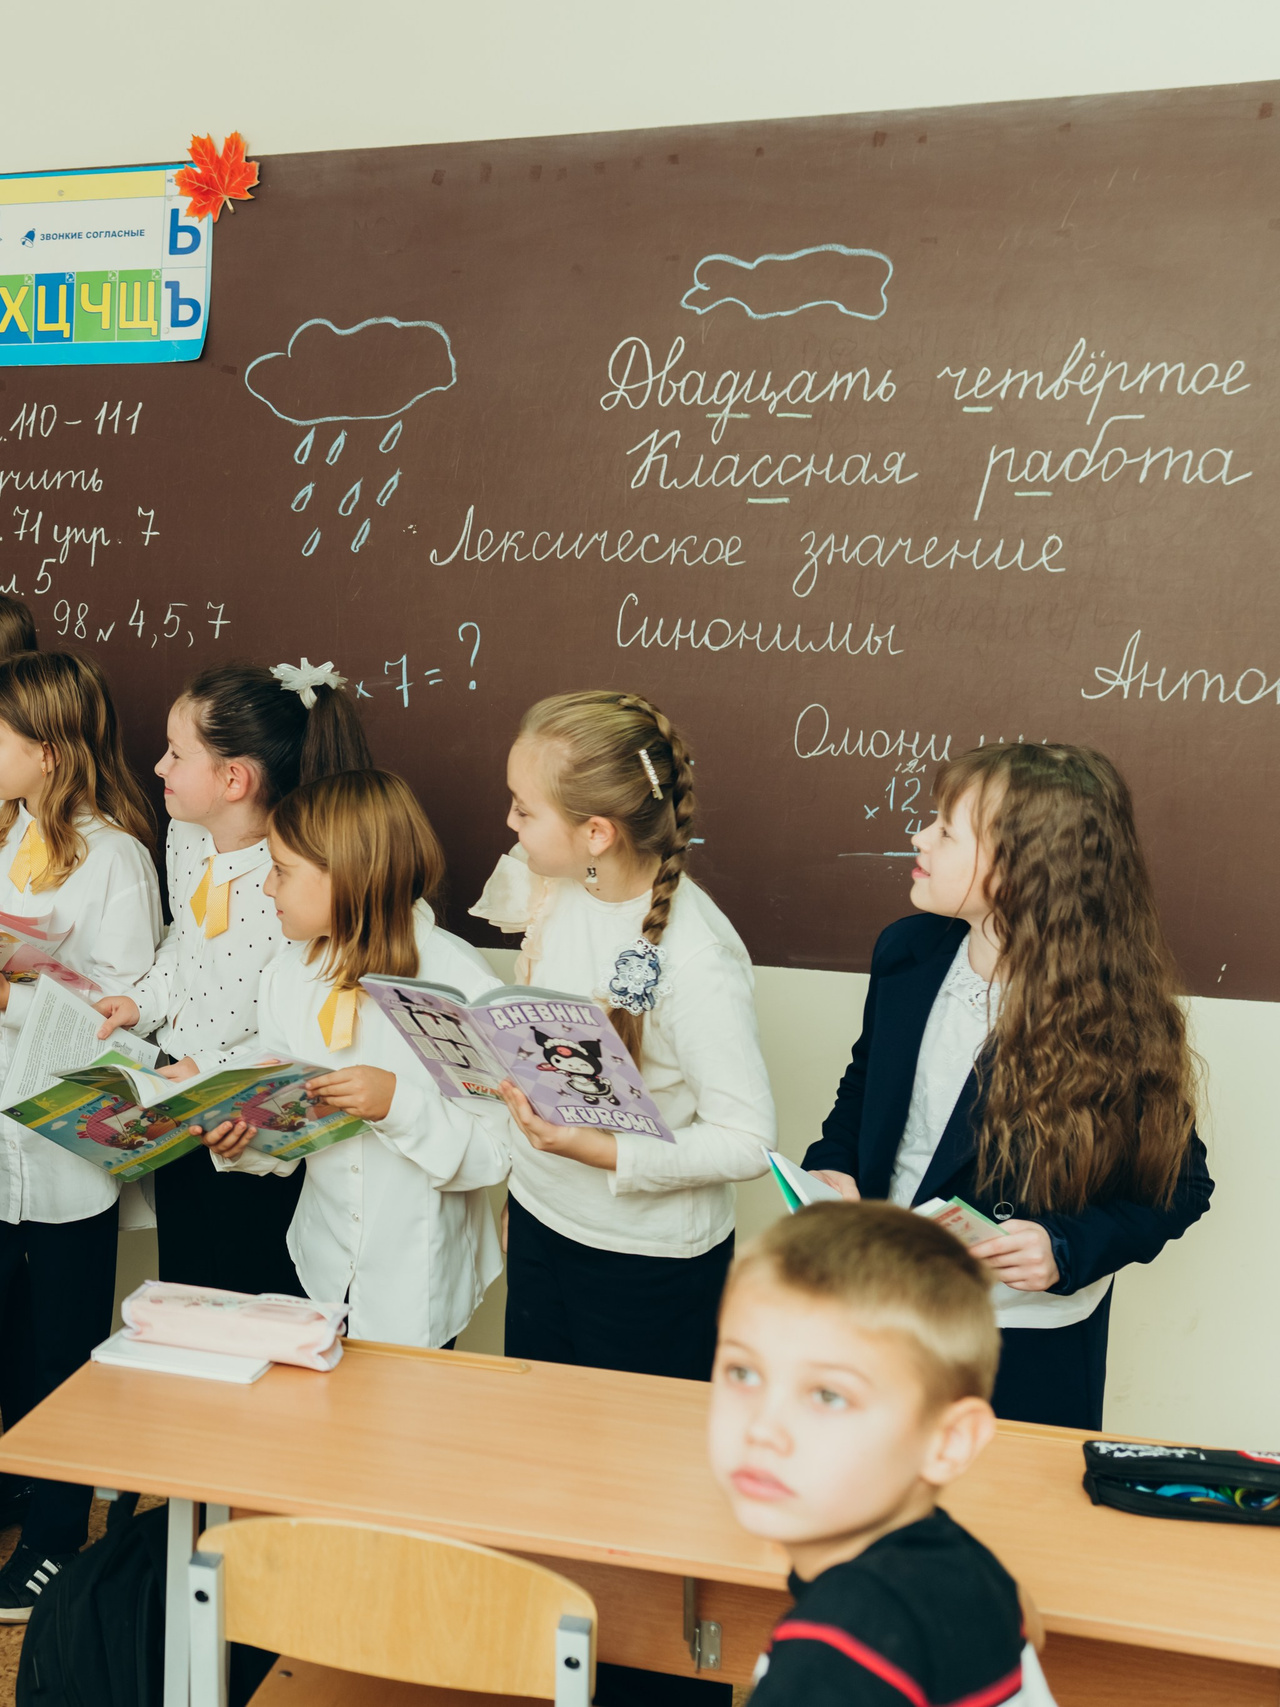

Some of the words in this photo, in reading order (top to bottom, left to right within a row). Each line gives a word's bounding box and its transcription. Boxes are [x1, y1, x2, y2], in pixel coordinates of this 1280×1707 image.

[40, 231, 84, 241] ЗВОНКИЕ
[86, 229, 145, 239] СОГЛАСНЫЕ
[599, 336, 896, 444] Двадцать
[937, 338, 1251, 425] четвёртое
[95, 401, 143, 435] 111
[627, 429, 918, 489] Классная
[974, 415, 1252, 521] работа
[13, 506, 42, 544] 71
[137, 506, 160, 546] 7
[430, 504, 746, 567] Лексическое
[792, 529, 1065, 598] значение
[34, 559, 56, 594] 5
[53, 599, 88, 639] 98
[616, 593, 904, 655] Синонимы
[794, 703, 1047, 761] Омони
[489, 1003, 600, 1030] ДНЕВНИК
[557, 1105, 662, 1137] KUROMI
